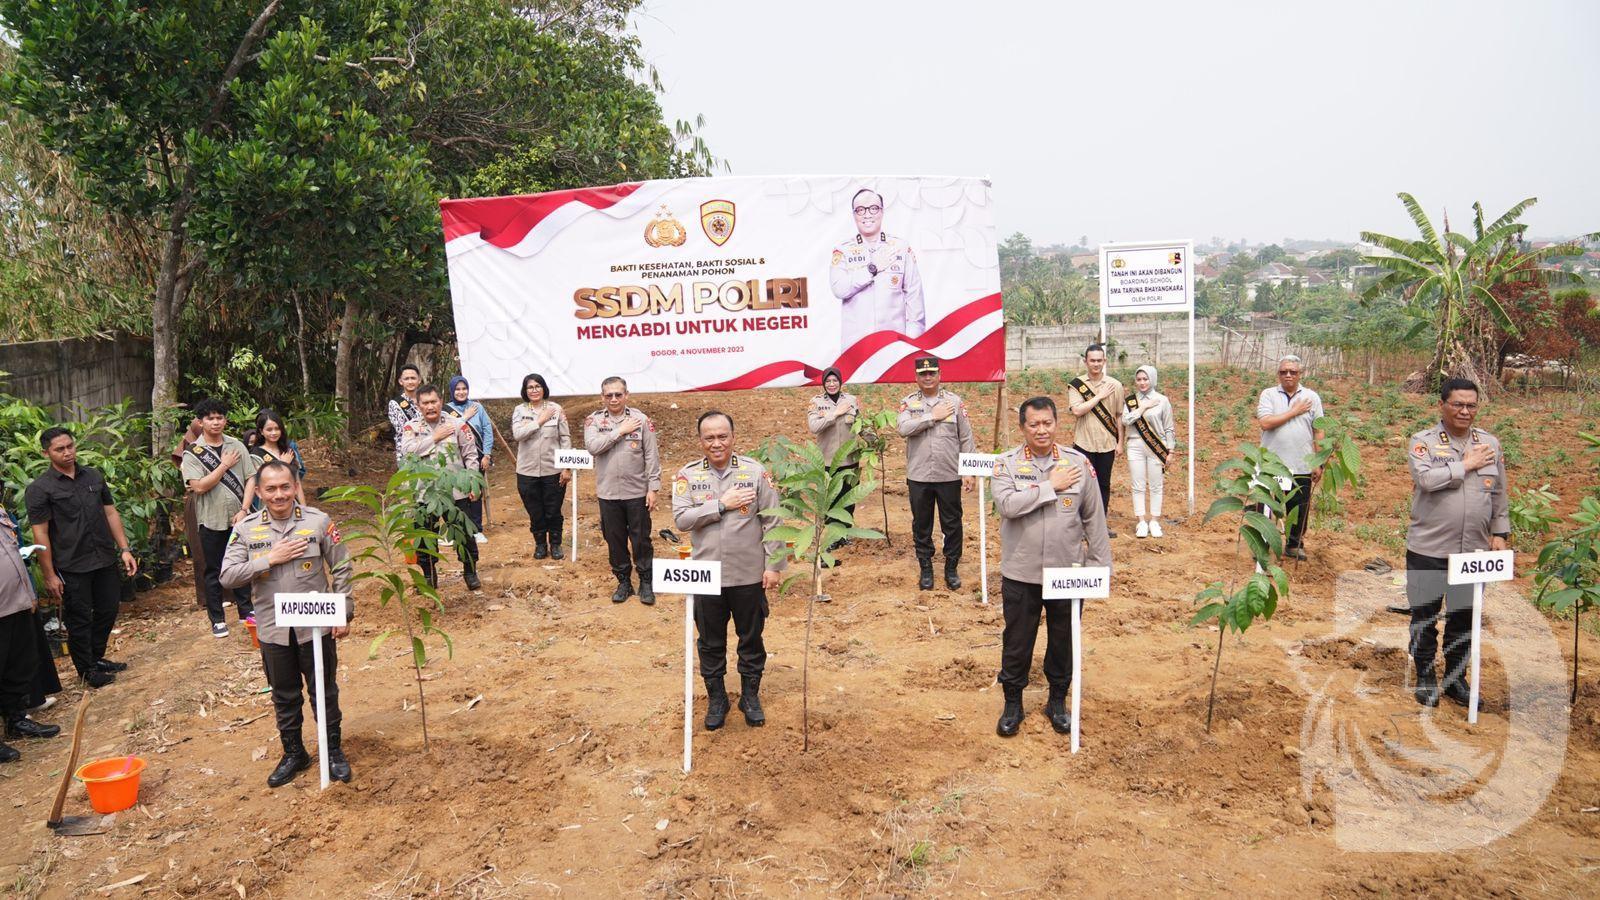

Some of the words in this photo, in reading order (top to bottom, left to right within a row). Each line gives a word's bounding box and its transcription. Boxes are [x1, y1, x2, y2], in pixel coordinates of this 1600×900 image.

[611, 264, 637, 273] BAKTI
[639, 261, 694, 271] KESEHATAN,
[696, 260, 723, 268] BAKTI
[725, 258, 757, 266] SOSIAL
[641, 270, 699, 279] PENANAMAN
[701, 267, 735, 276] POHON
[1144, 285, 1184, 293] BHAYANGKARA
[573, 283, 684, 319] SSDM
[693, 277, 808, 313] POLRI
[577, 322, 671, 340] MENGABDI
[675, 318, 738, 335] UNTUK
[743, 315, 808, 331] NEGERI
[685, 347, 727, 355] NOVEMBER
[559, 456, 590, 465] KAPUSKU
[962, 459, 995, 469] KADIVKU
[1461, 559, 1504, 574] ASLOG
[663, 568, 711, 583] ASSDM
[1052, 578, 1103, 589] KALEMDIKLAT
[281, 602, 336, 615] KAPUSDOKES
